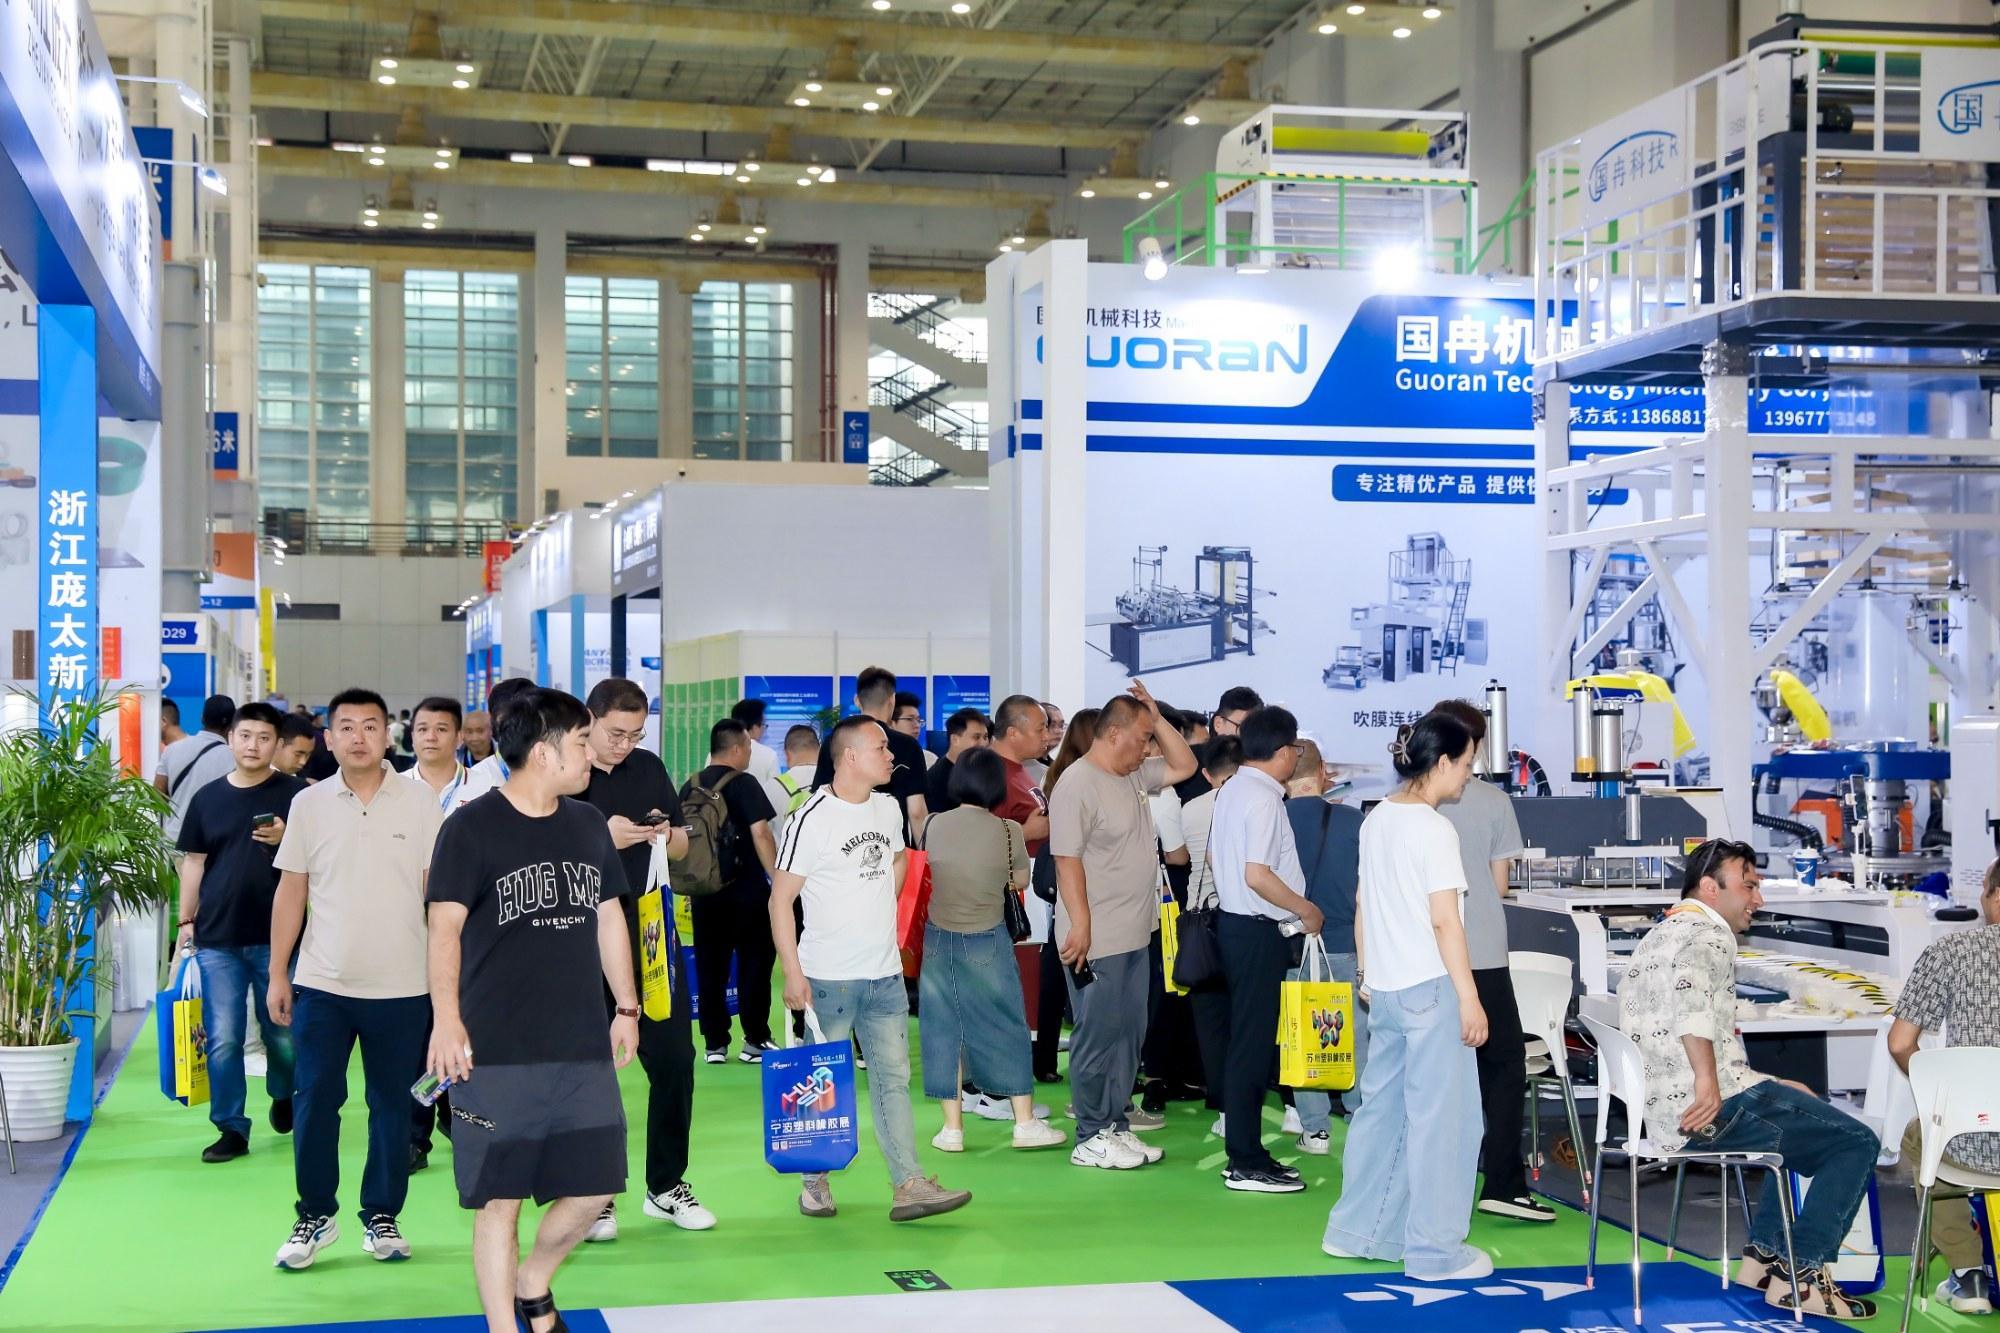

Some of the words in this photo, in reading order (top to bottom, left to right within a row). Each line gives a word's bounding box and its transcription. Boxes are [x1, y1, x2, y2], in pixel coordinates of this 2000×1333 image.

[1396, 368, 1488, 392] Guoran
[1355, 473, 1477, 495] 专注精优产品
[496, 862, 558, 925] HUG
[562, 861, 601, 913] ME
[532, 915, 586, 927] GIVENCHY
